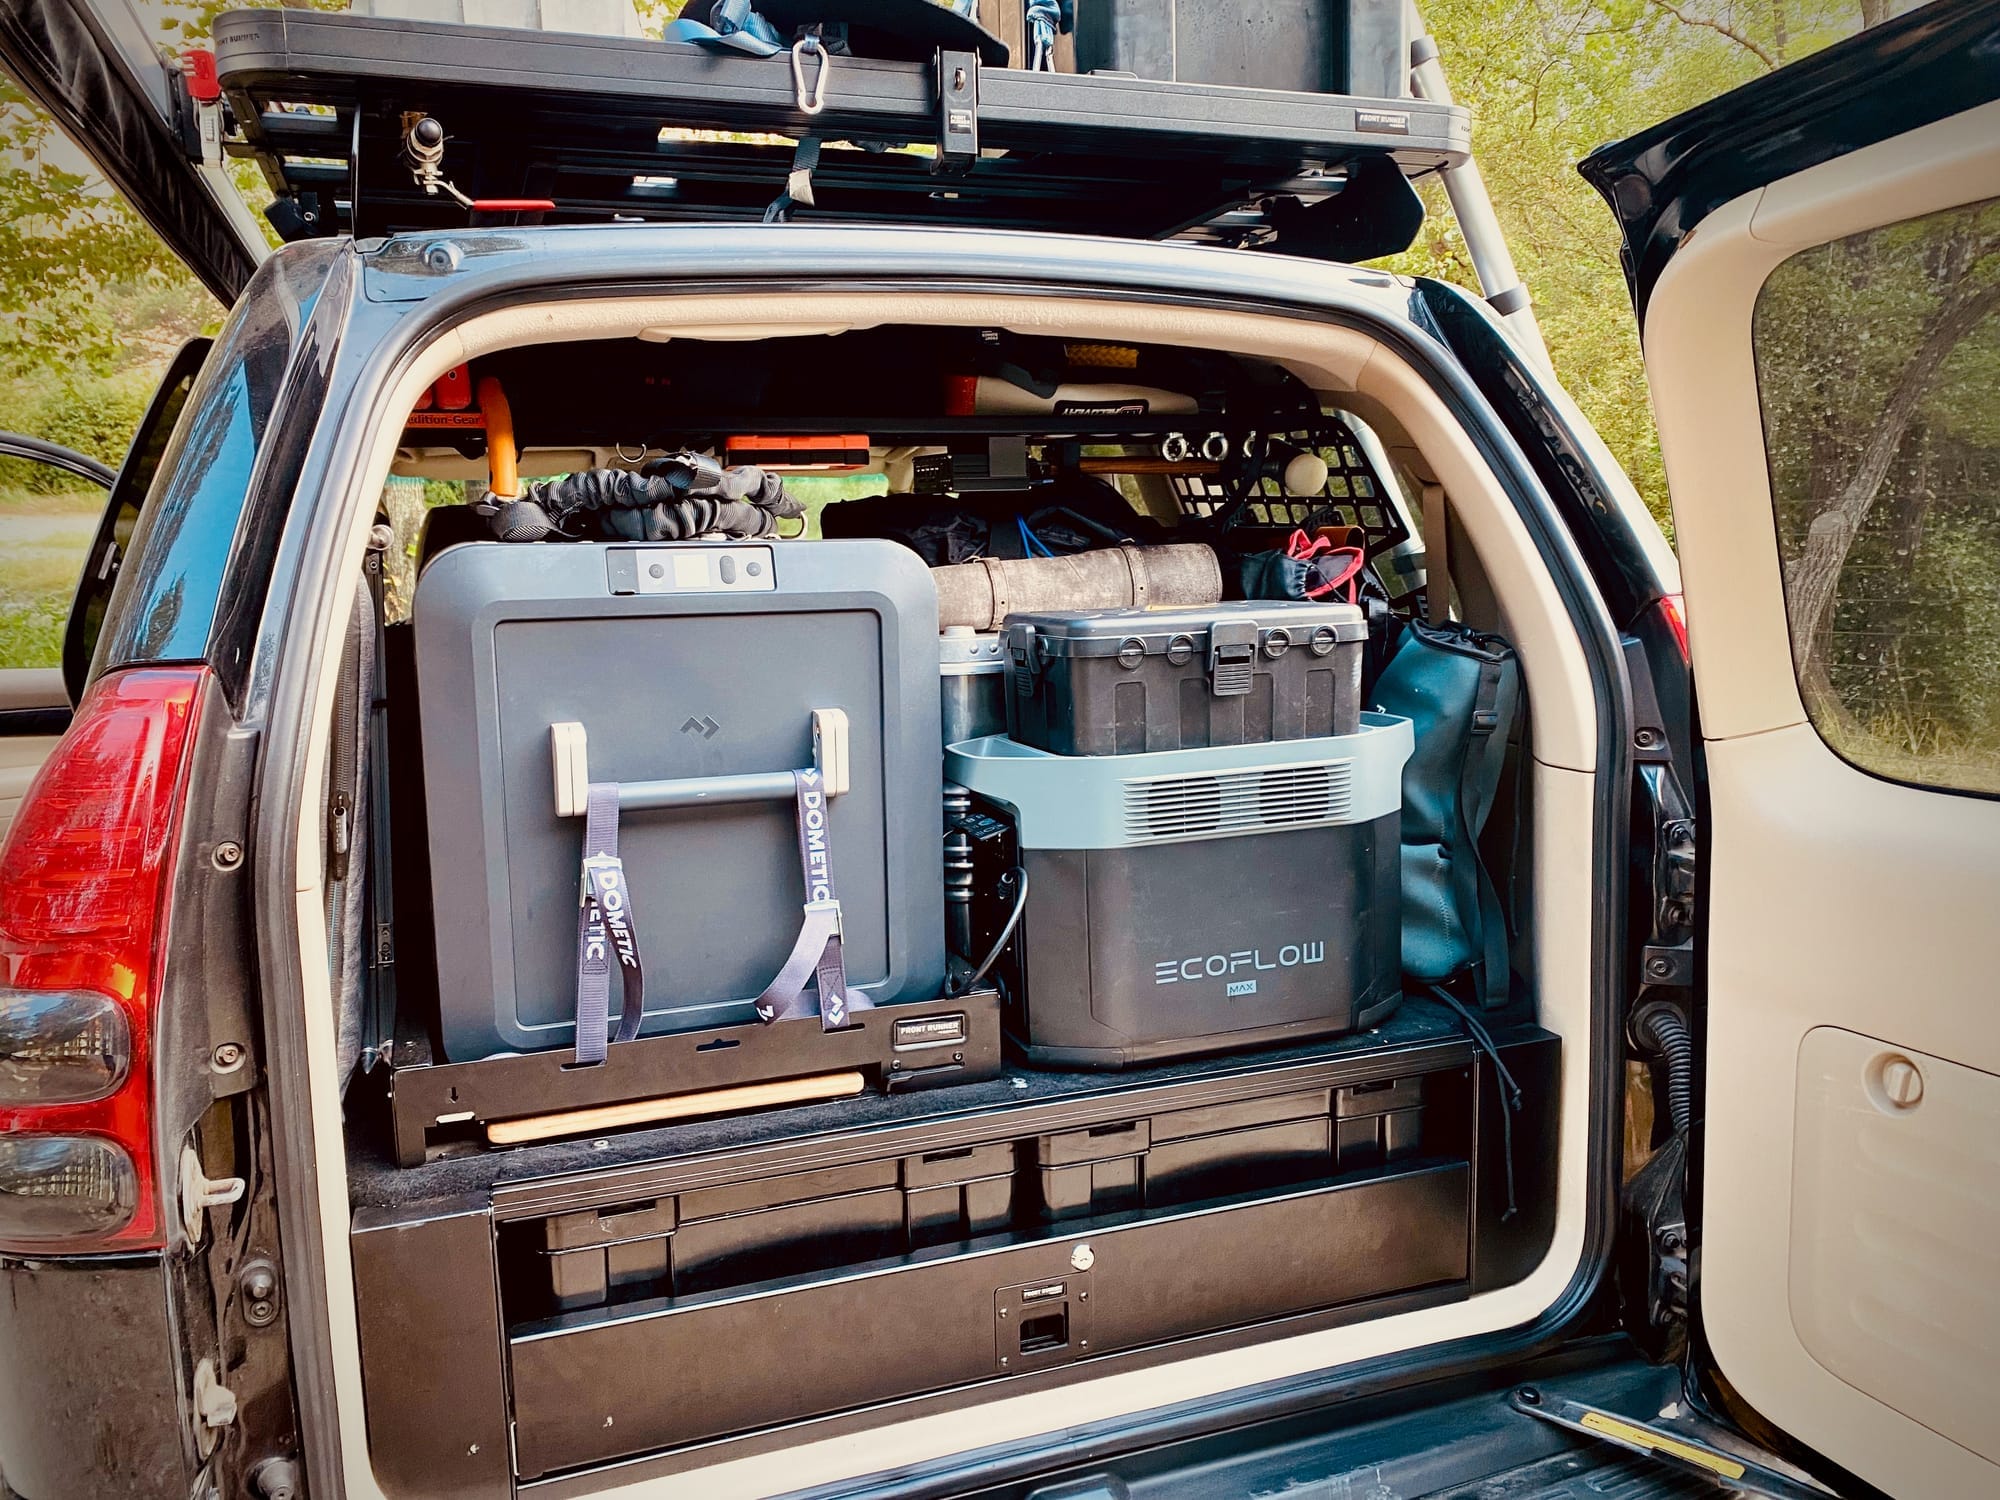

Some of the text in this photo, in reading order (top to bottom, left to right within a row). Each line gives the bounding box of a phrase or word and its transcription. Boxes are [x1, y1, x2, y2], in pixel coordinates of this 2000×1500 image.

[586, 901, 606, 961] ETIC
[598, 870, 637, 969] DOMETIC
[1155, 941, 1324, 985] ECOFLOW
[1229, 982, 1254, 995] MAX
[900, 1025, 927, 1035] FRONT
[927, 1021, 960, 1032] RUNNER
